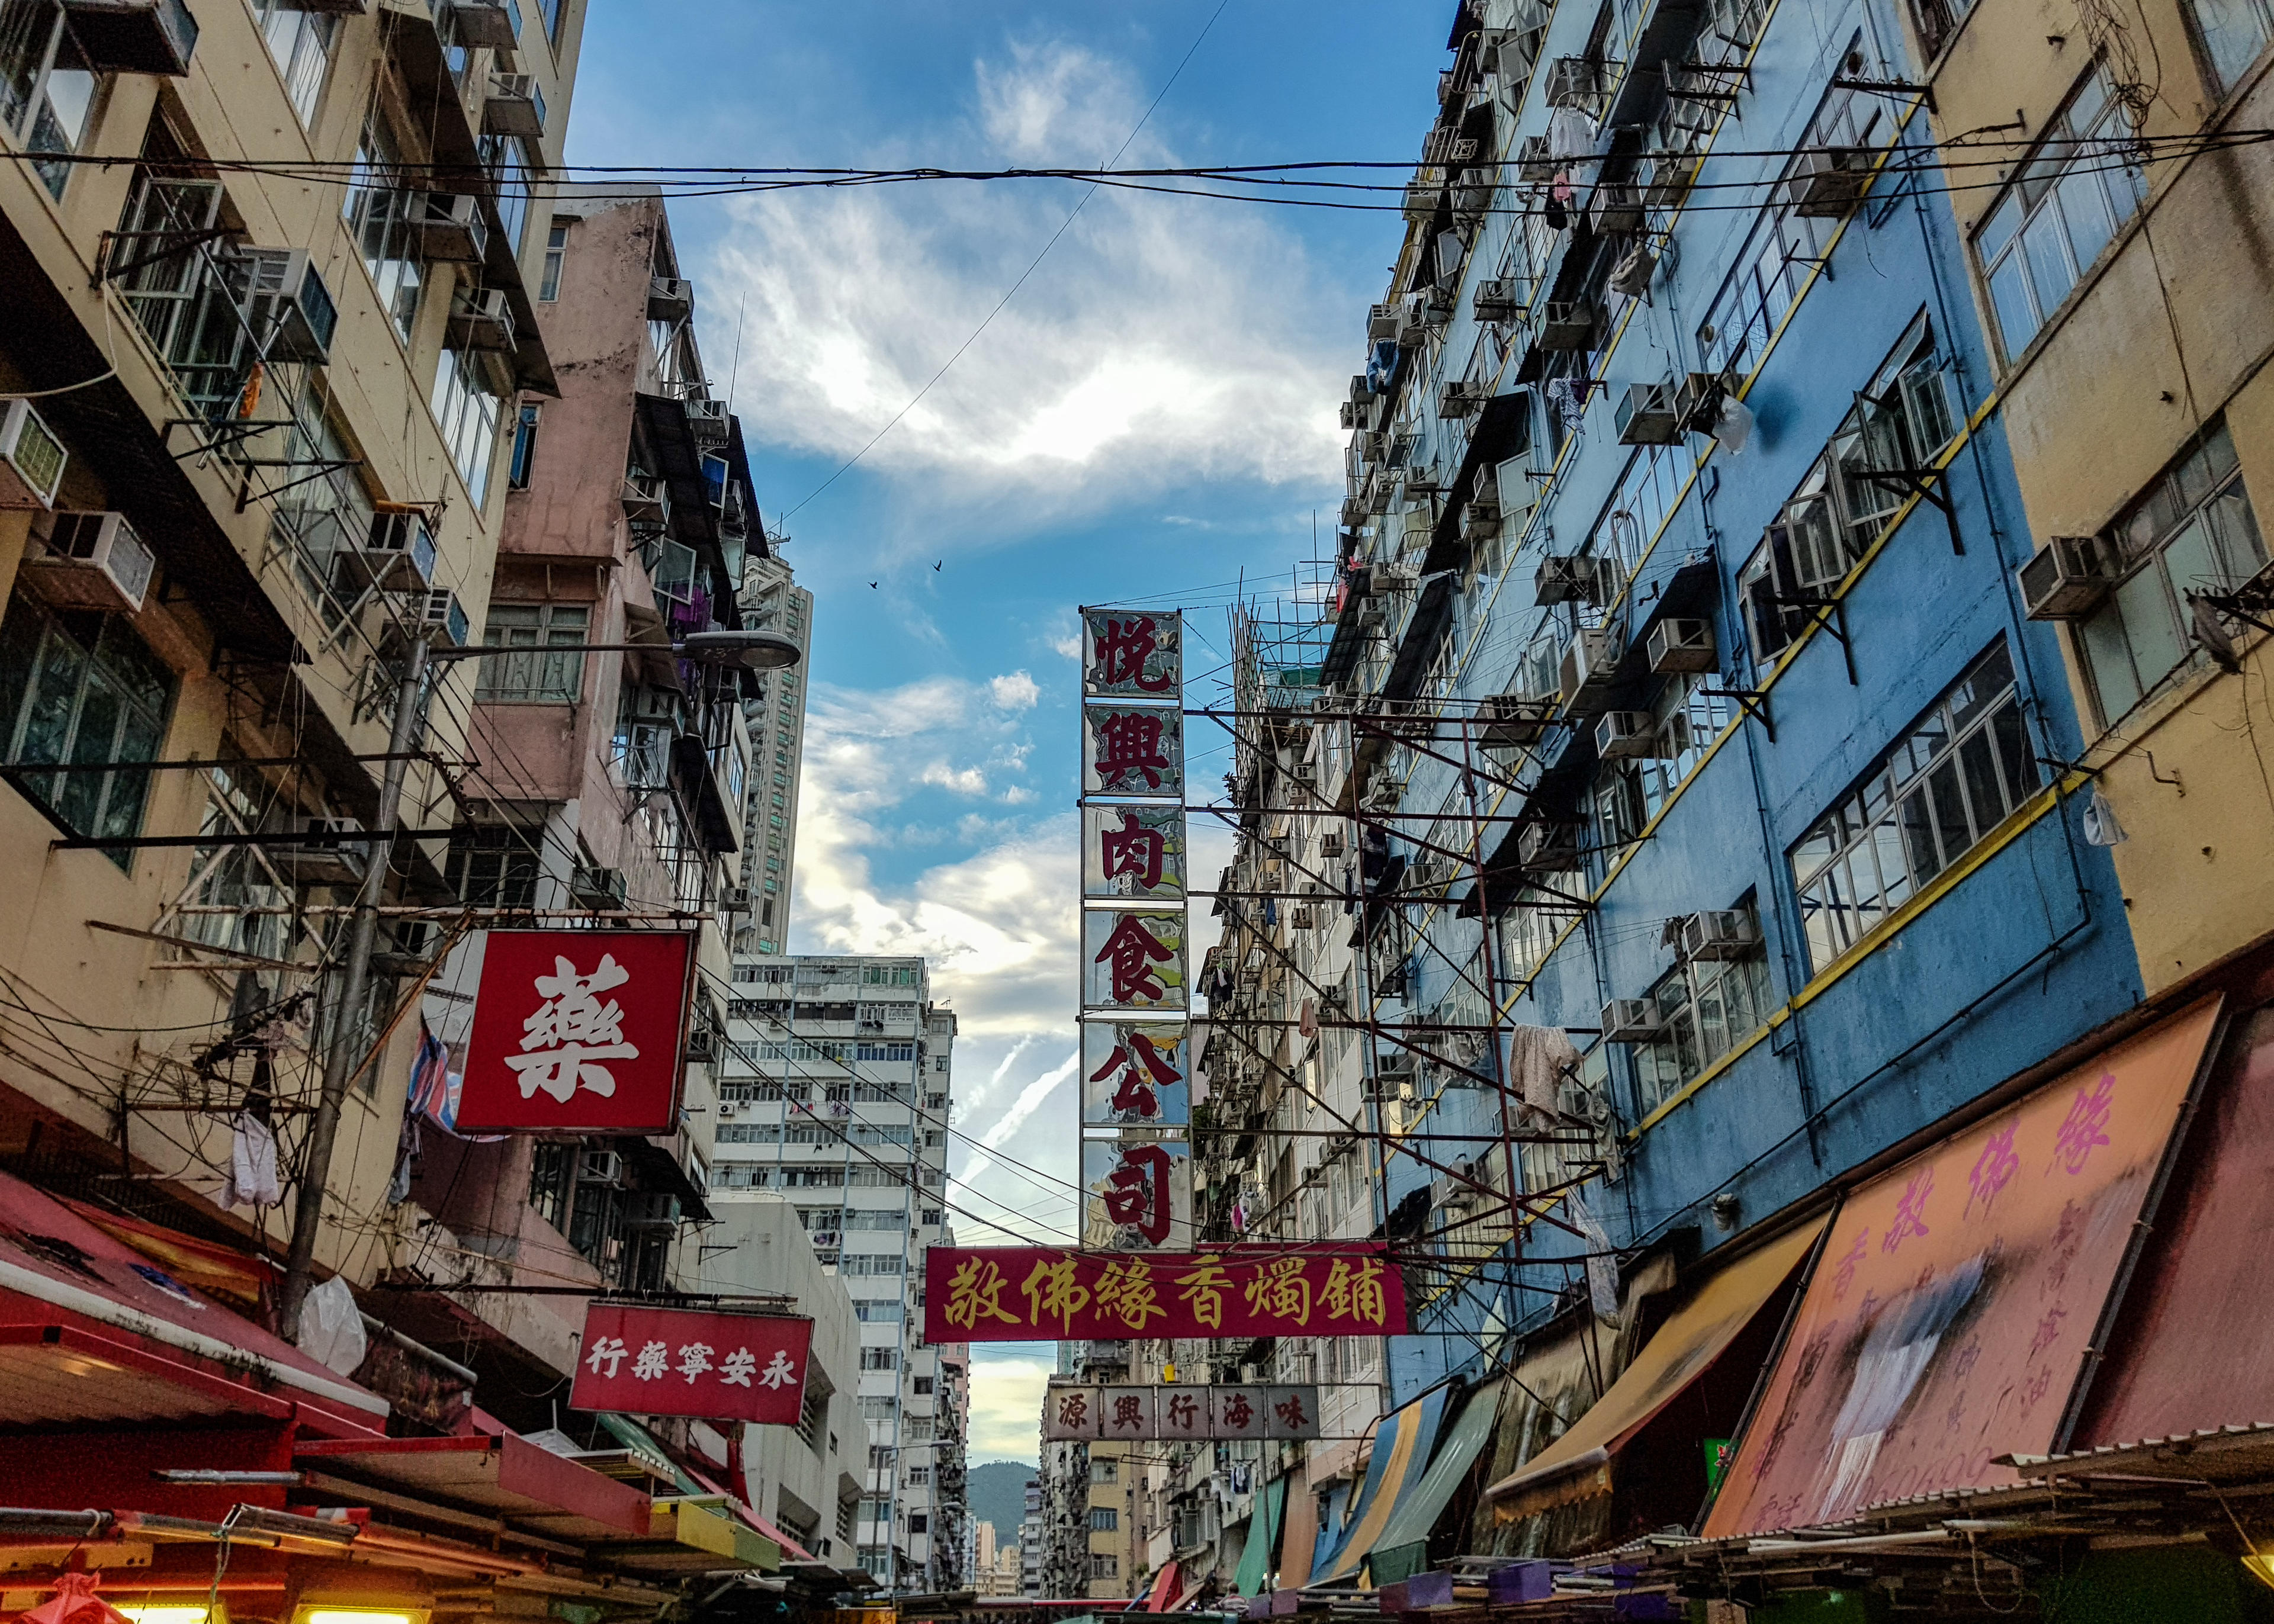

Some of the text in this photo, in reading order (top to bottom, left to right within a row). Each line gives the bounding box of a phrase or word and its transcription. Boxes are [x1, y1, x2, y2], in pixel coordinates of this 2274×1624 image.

[503, 953, 640, 1104] 藥
[1058, 1393, 1309, 1431] 源興行海味
